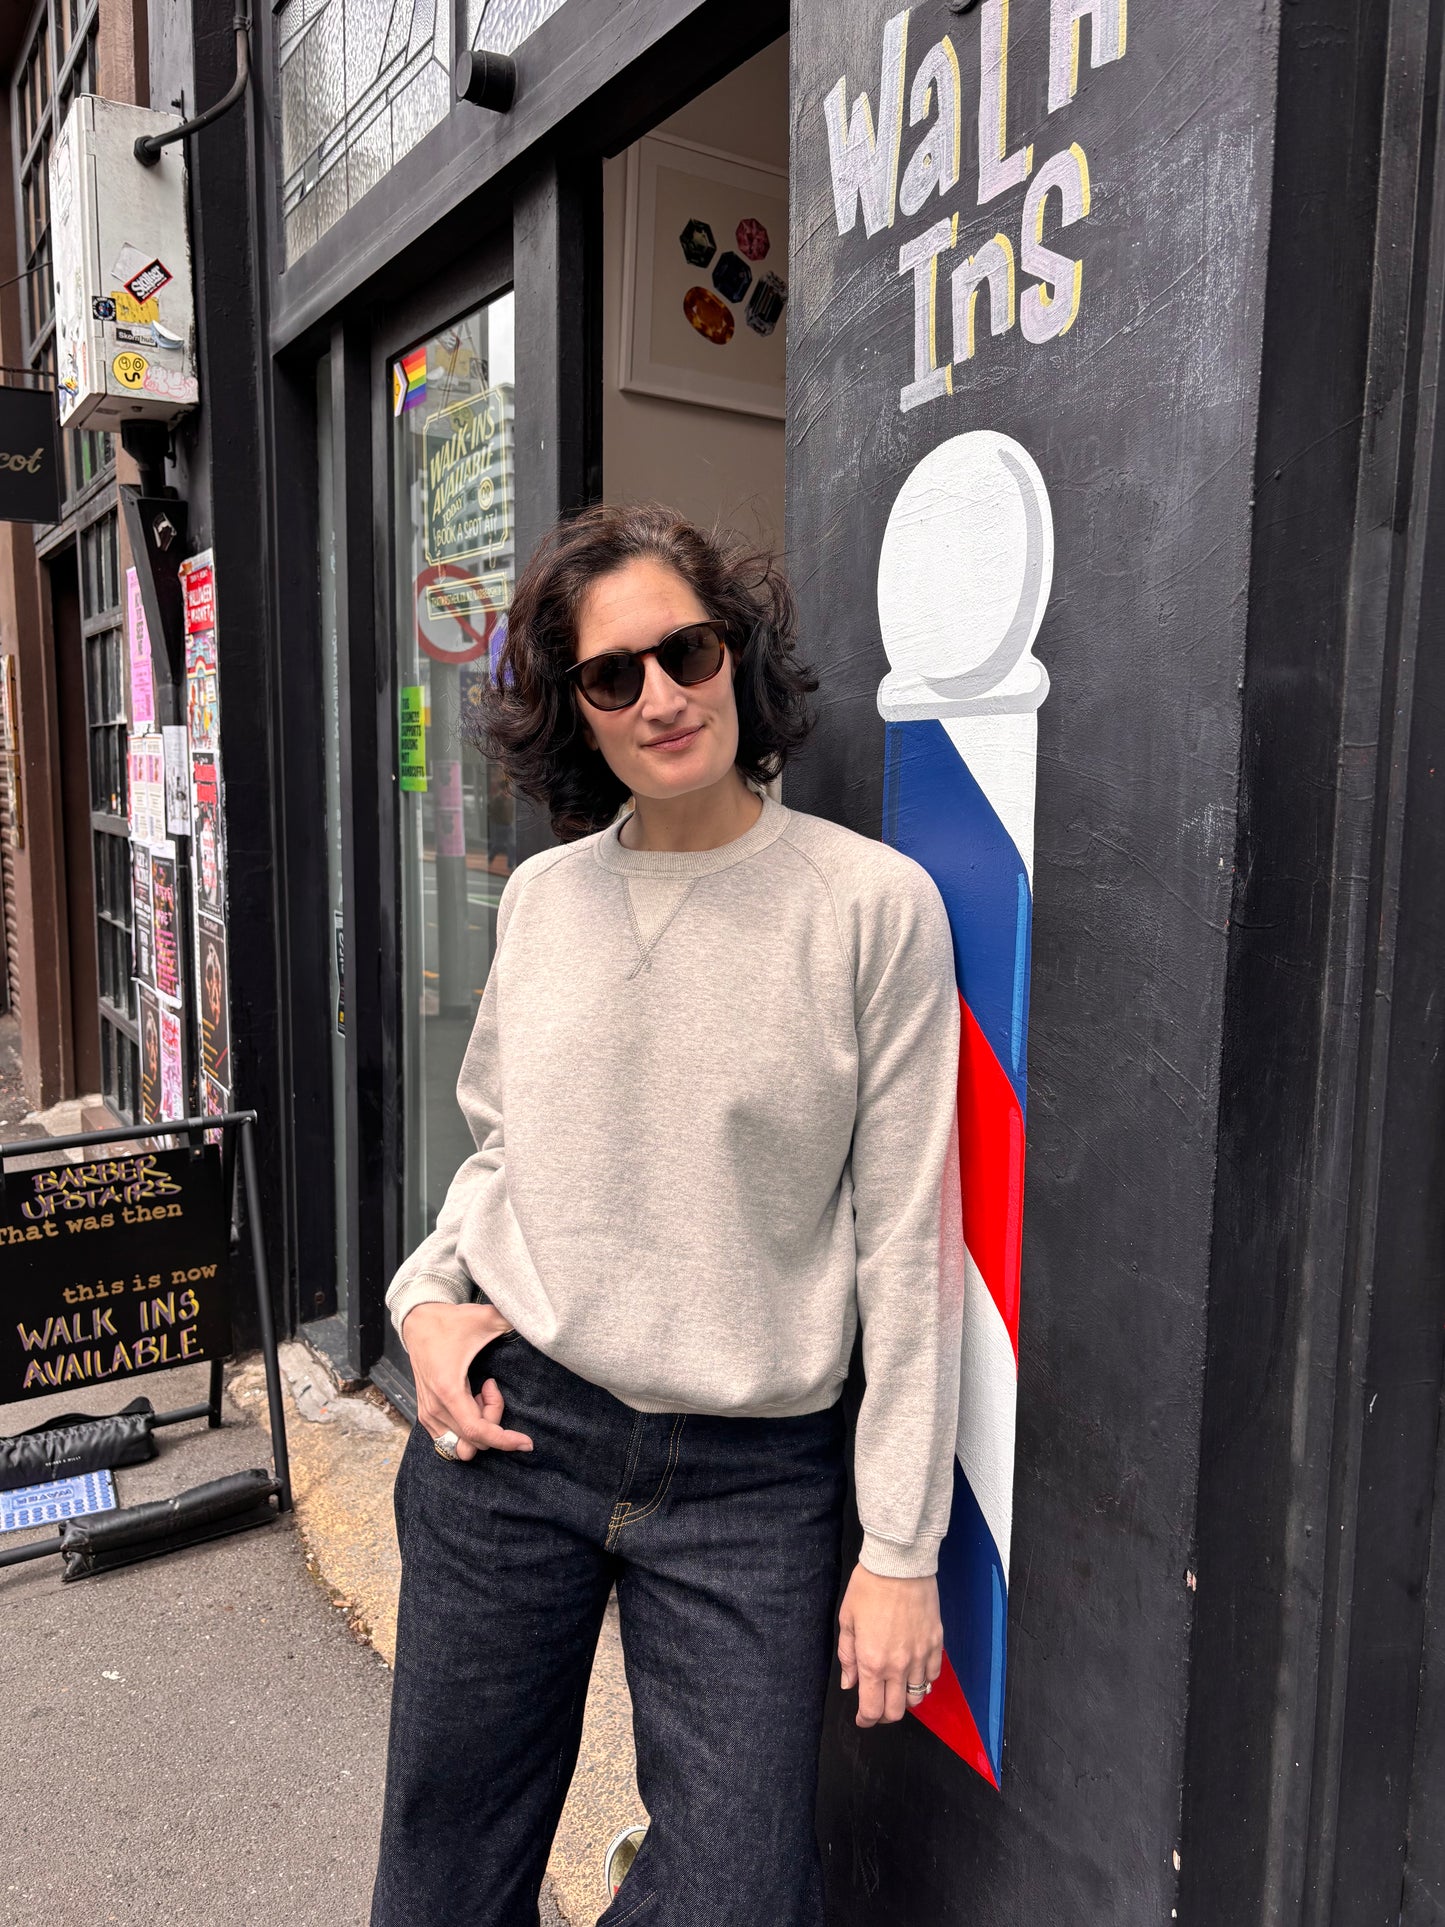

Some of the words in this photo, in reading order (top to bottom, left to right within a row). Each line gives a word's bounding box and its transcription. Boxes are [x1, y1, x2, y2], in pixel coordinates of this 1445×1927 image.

[430, 407, 495, 490] WALK-INS
[432, 442, 495, 521] AVAILABLE
[443, 496, 464, 526] TODAY
[31, 1155, 169, 1193] BARBER
[21, 1176, 182, 1219] UPSTAIRS
[66, 1213, 115, 1234] was
[122, 1203, 183, 1224] then
[62, 1280, 124, 1304] this
[132, 1273, 161, 1293] is
[171, 1264, 218, 1284] now
[16, 1307, 118, 1351] WALK
[139, 1289, 200, 1333] INS
[22, 1324, 204, 1389] AVAILABLE
